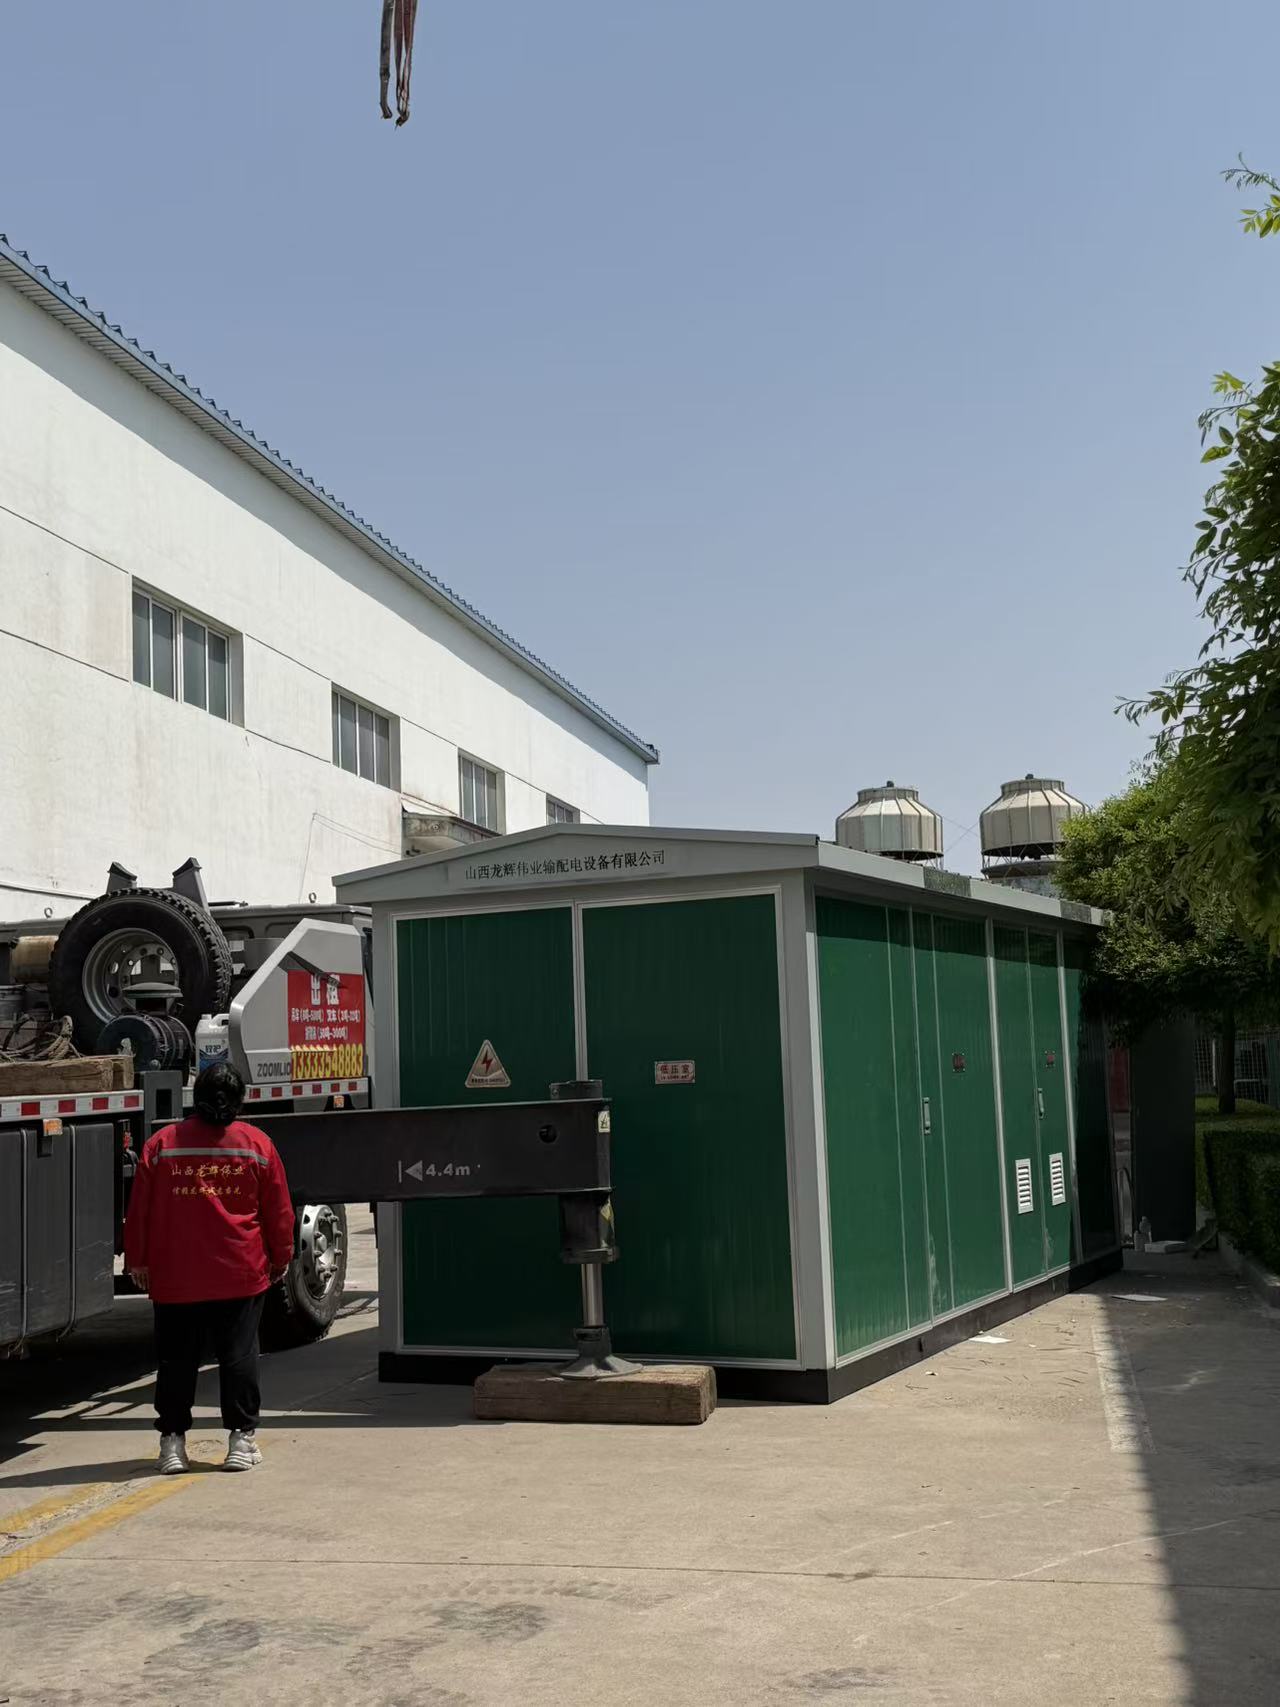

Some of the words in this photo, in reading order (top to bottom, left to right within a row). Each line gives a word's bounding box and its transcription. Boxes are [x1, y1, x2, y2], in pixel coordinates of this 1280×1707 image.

[465, 849, 665, 880] 山西龙辉伟业输配电设备有限公司
[310, 973, 341, 1006] 出租
[291, 1043, 363, 1080] 13333548883
[425, 1163, 471, 1177] 4.4m
